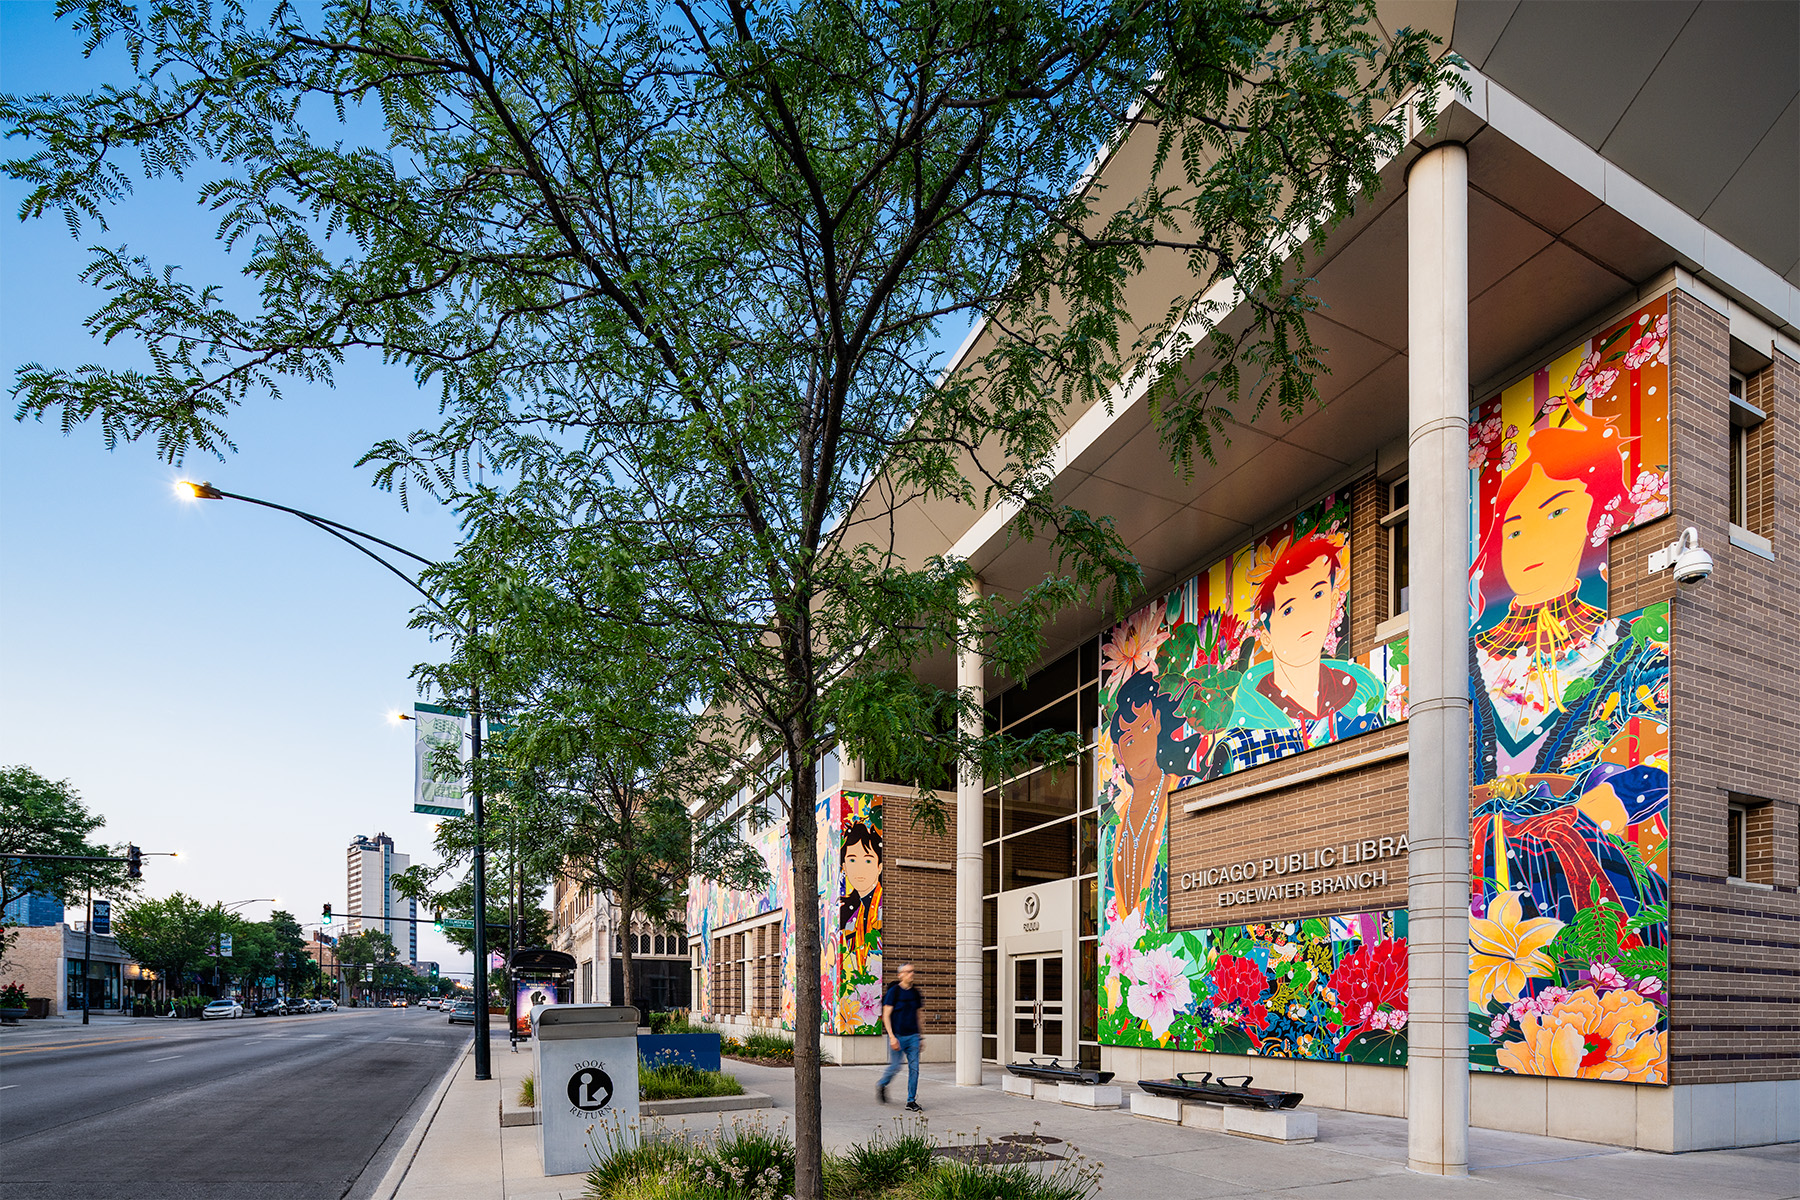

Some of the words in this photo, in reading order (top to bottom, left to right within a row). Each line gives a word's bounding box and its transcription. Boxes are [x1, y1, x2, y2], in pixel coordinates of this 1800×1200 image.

[1180, 861, 1257, 890] CHICAGO
[1262, 847, 1336, 877] PUBLIC
[1218, 882, 1306, 908] EDGEWATER
[1311, 869, 1388, 896] BRANCH
[574, 1060, 606, 1071] BOOK
[569, 1104, 612, 1120] RETURN
